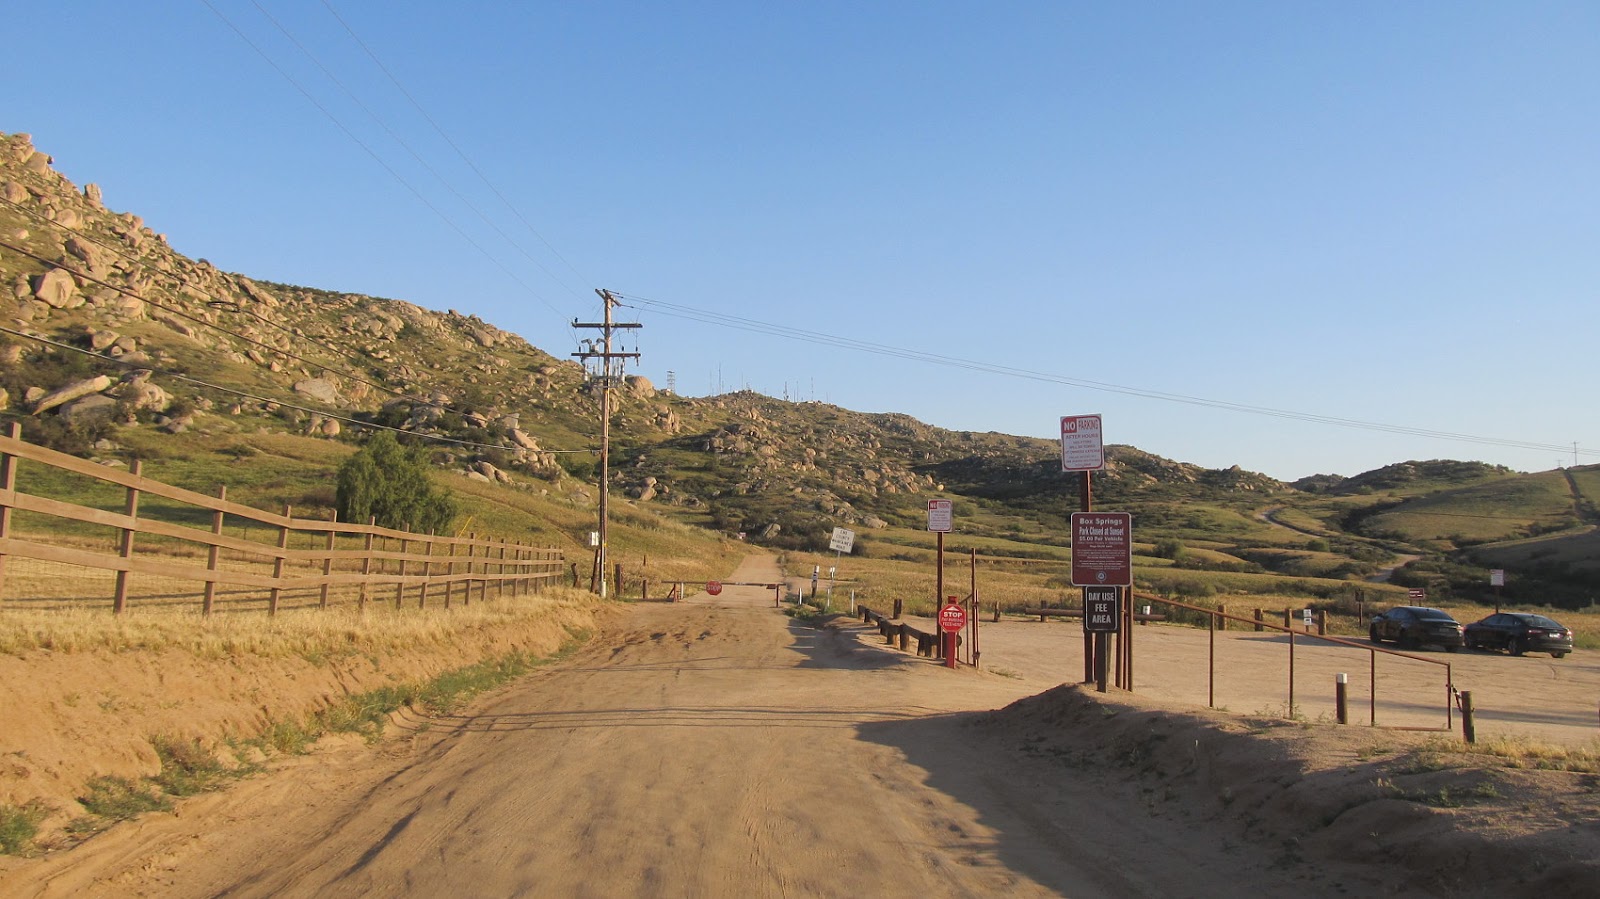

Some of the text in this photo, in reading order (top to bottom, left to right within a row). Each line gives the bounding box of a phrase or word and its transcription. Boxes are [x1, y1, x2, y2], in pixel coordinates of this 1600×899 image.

[1064, 419, 1098, 431] NO PARKING
[1079, 526, 1124, 535] Park Closed at Sunset
[1089, 593, 1114, 601] DAY USE
[1095, 603, 1108, 612] FEE
[1092, 614, 1111, 623] AREA
